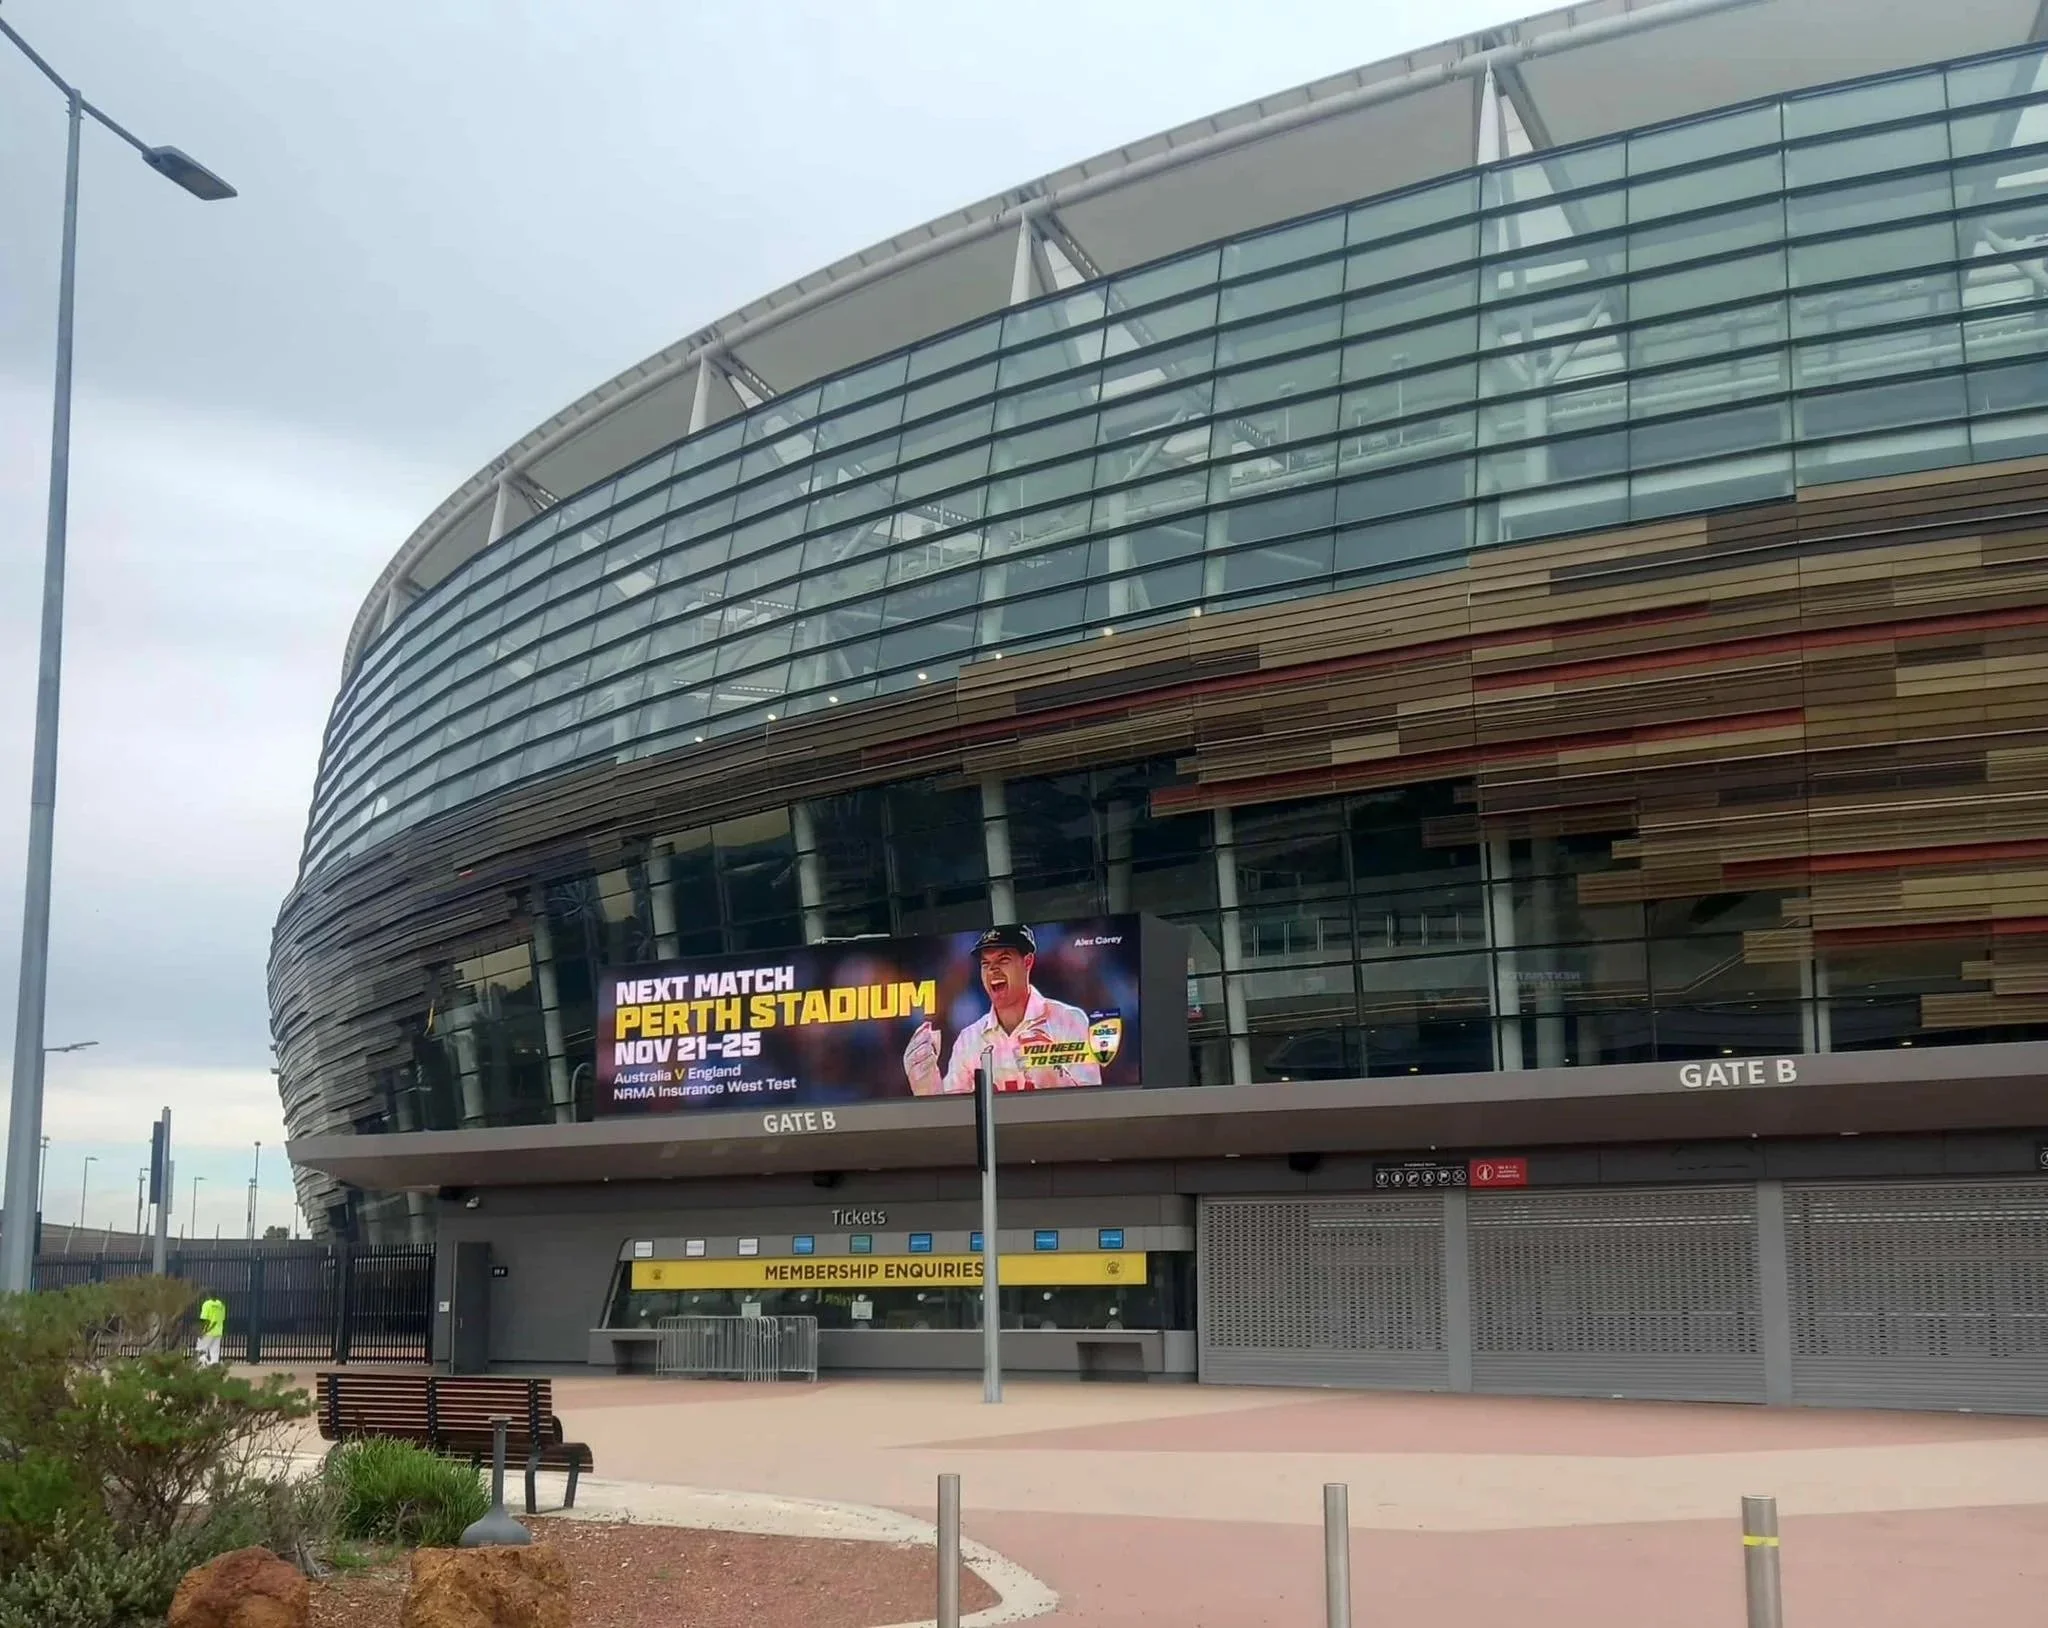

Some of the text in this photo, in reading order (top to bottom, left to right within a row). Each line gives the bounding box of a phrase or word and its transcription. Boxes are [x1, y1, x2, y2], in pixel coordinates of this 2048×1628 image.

[1074, 936, 1122, 948] Alex Carey
[616, 966, 794, 1005] NEXT MATCH
[616, 980, 936, 1039] PERTH STADIUM
[615, 1039, 673, 1066] NOV
[1024, 1042, 1085, 1054] YOU NEED
[1030, 1053, 1089, 1065] TO SEE IT
[614, 1064, 741, 1084] Australia V England
[1680, 1059, 1797, 1088] GATE B
[614, 1078, 796, 1100] NRMA Insurance West Test
[763, 1111, 836, 1133] GATE B
[832, 1209, 886, 1225] Tickets
[765, 1262, 984, 1280] MEMBERSHIP ENQUIRIES
